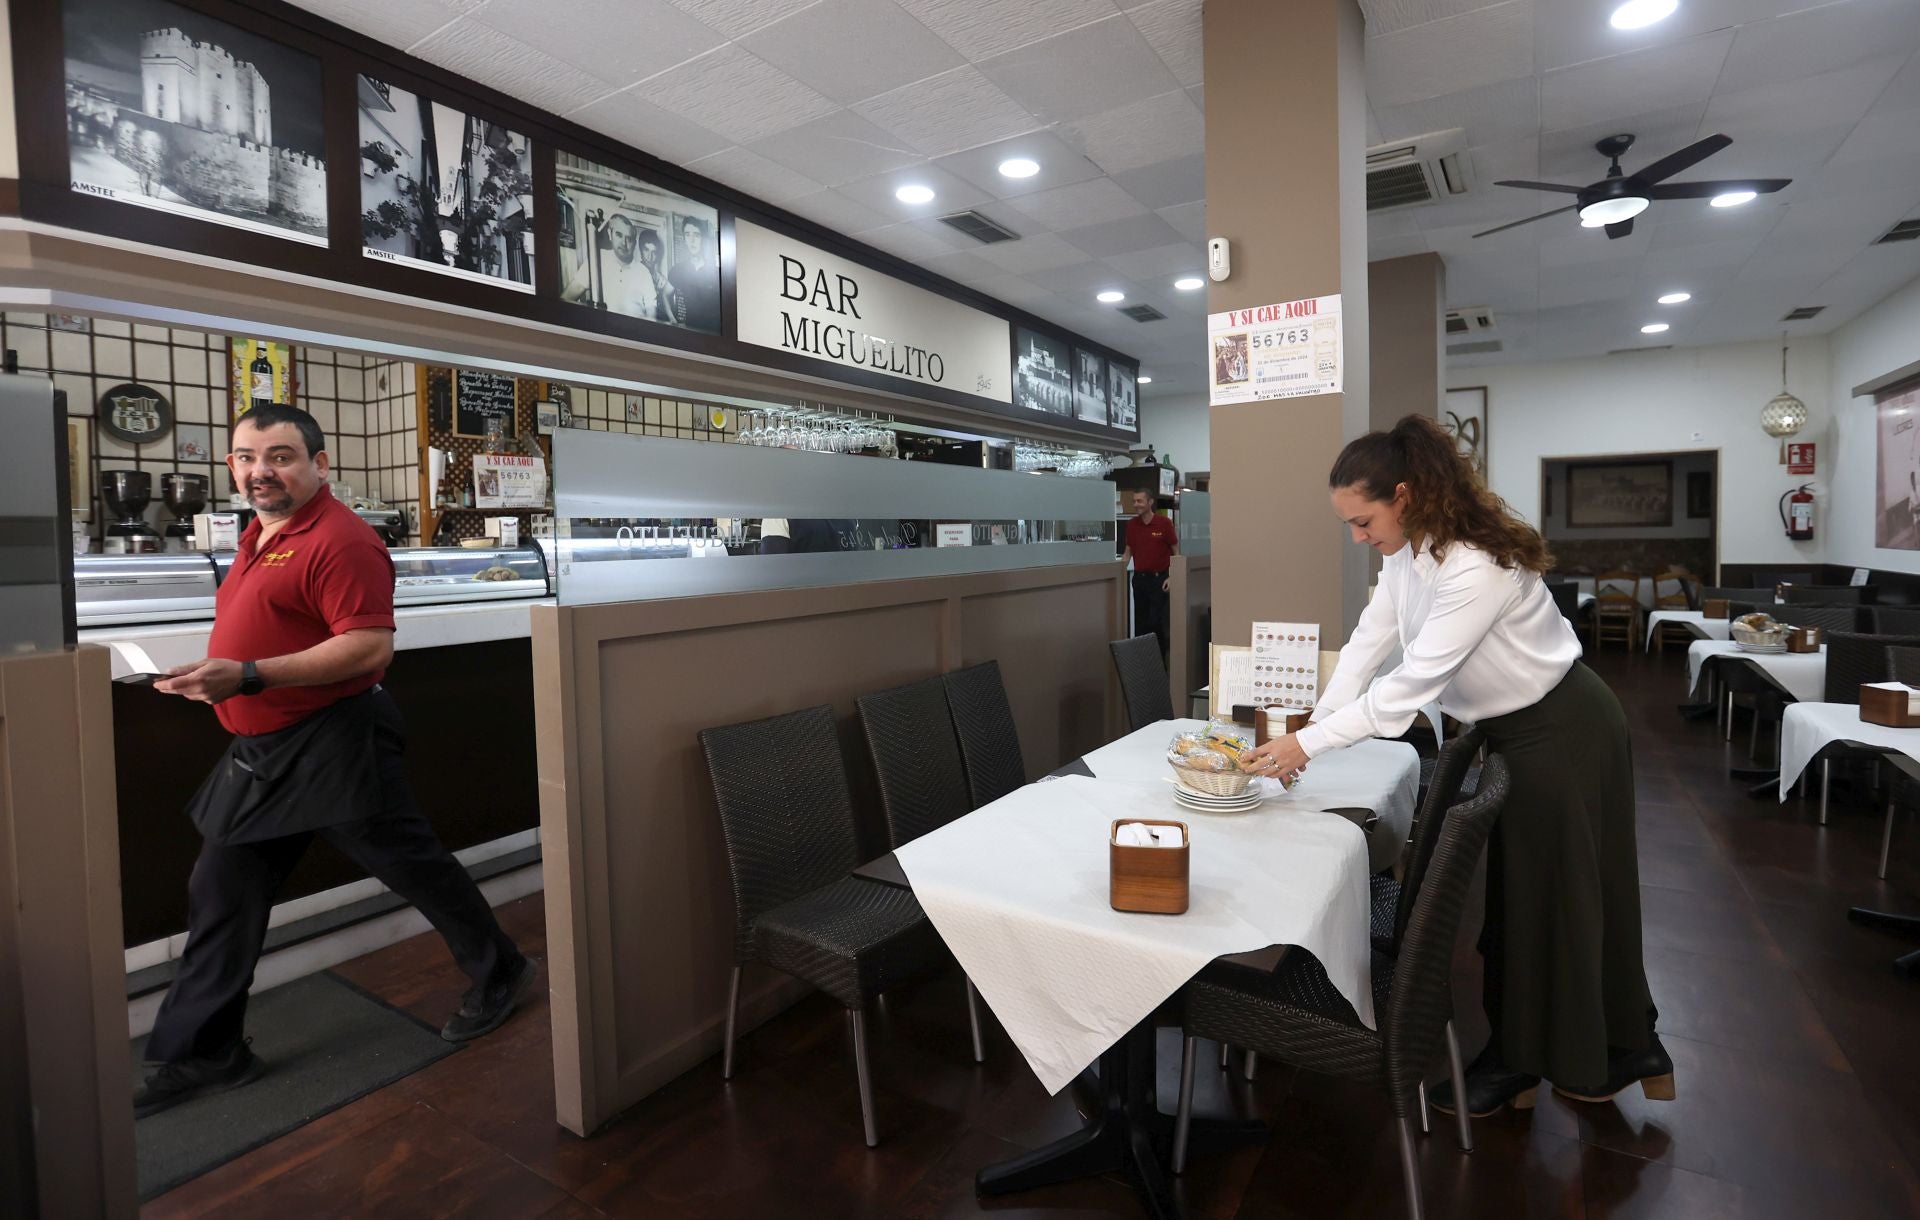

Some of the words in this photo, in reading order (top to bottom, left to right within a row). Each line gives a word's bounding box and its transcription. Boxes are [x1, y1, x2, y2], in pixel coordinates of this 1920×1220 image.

[71, 181, 115, 198] AMSTEL
[367, 249, 396, 261] AMSTEL
[779, 254, 862, 319] BAR
[1229, 312, 1236, 327] Y
[1241, 309, 1253, 325] SI
[1257, 305, 1280, 323] CAE
[1285, 299, 1317, 319] AQUI
[780, 311, 944, 383] MIGUELITO
[1253, 329, 1309, 348] 56763
[503, 457, 516, 466] CAE
[501, 471, 531, 480] 56763
